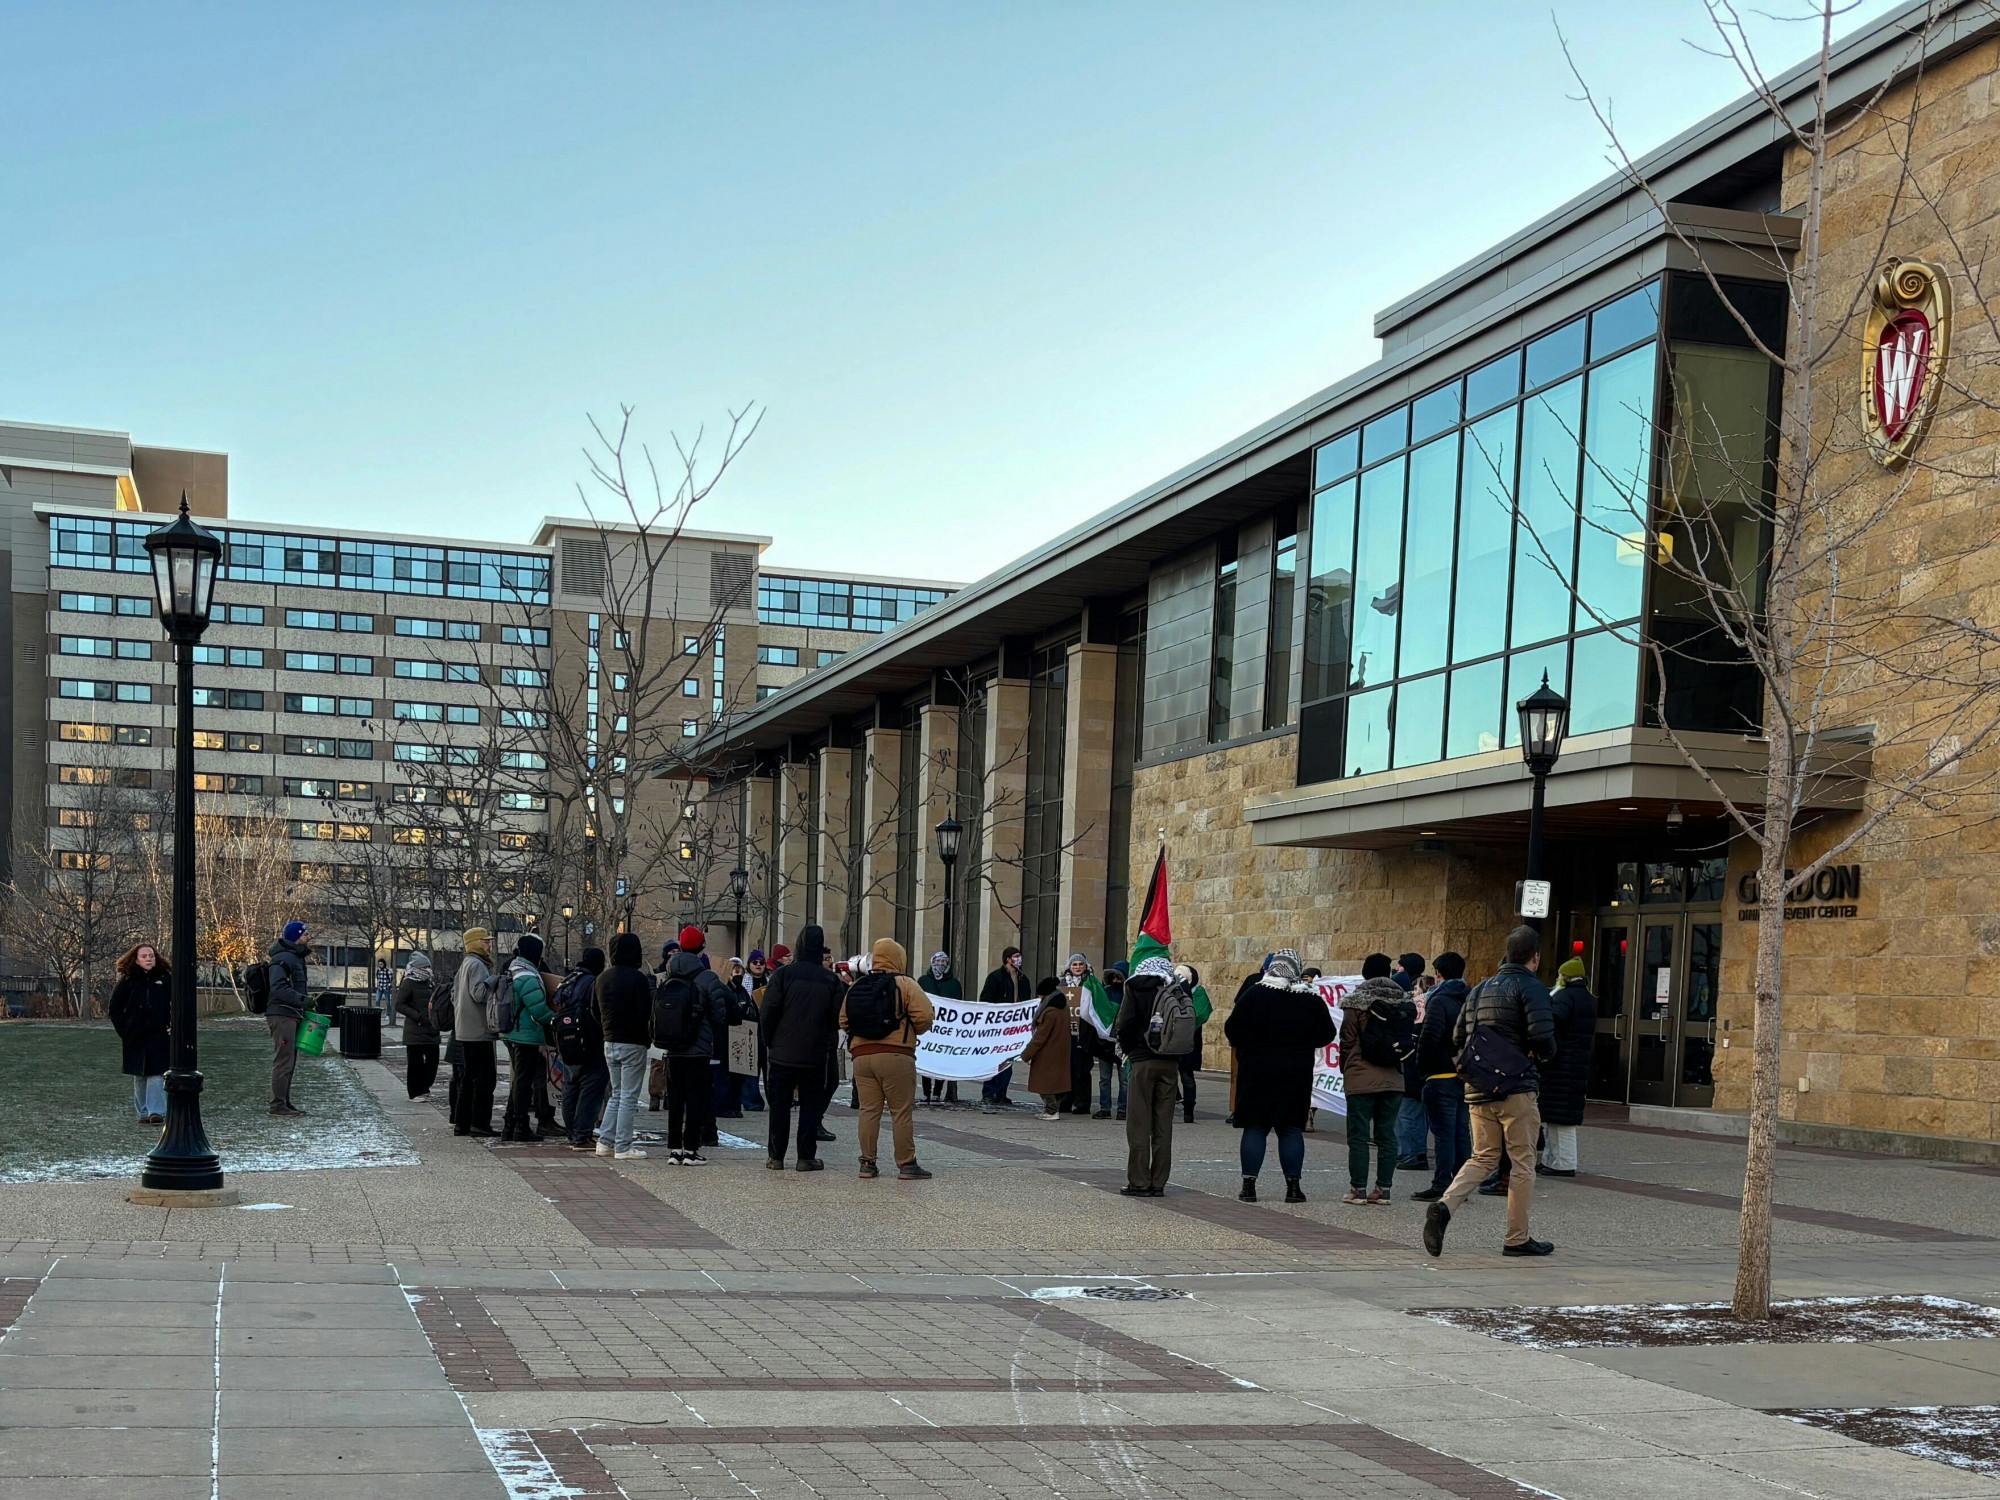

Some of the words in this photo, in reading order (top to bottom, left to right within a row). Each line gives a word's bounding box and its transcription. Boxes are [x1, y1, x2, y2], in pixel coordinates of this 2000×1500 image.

[1881, 329, 1926, 425] W
[1737, 865, 1860, 904] GDON
[1783, 906, 1817, 920] EVENT
[1817, 904, 1858, 919] CENTER
[931, 1005, 958, 1023] RD
[961, 1011, 983, 1025] OF
[955, 1028, 977, 1039] YOU
[977, 1028, 1001, 1038] WITH
[921, 1041, 971, 1056] JUSTICE!
[971, 1045, 990, 1056] NO
[990, 1040, 1025, 1055] PEACE!
